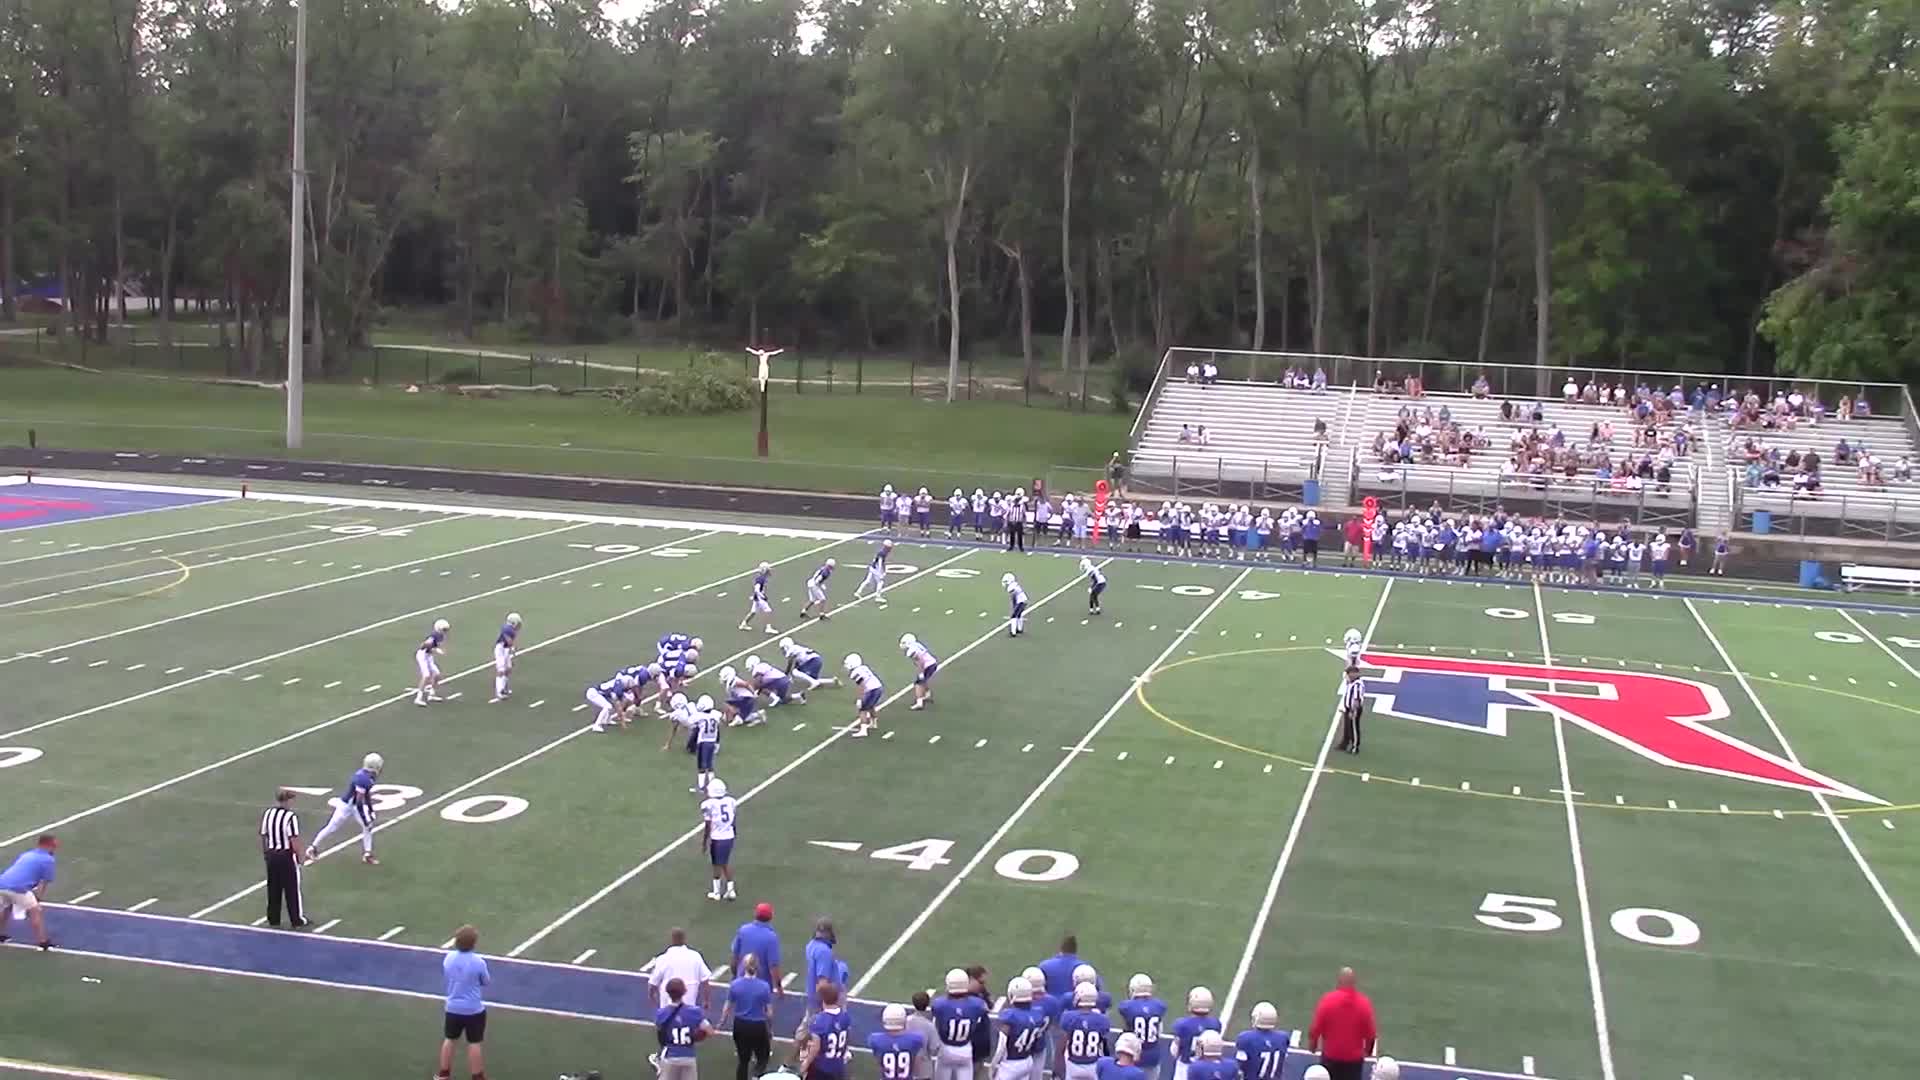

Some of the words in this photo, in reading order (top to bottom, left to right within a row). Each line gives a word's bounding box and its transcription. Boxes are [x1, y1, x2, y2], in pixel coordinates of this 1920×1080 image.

[720, 804, 730, 823] 5
[948, 1019, 971, 1042] 10
[1071, 1030, 1100, 1056] 88
[883, 1052, 911, 1079] 99
[1260, 1051, 1281, 1079] 71
